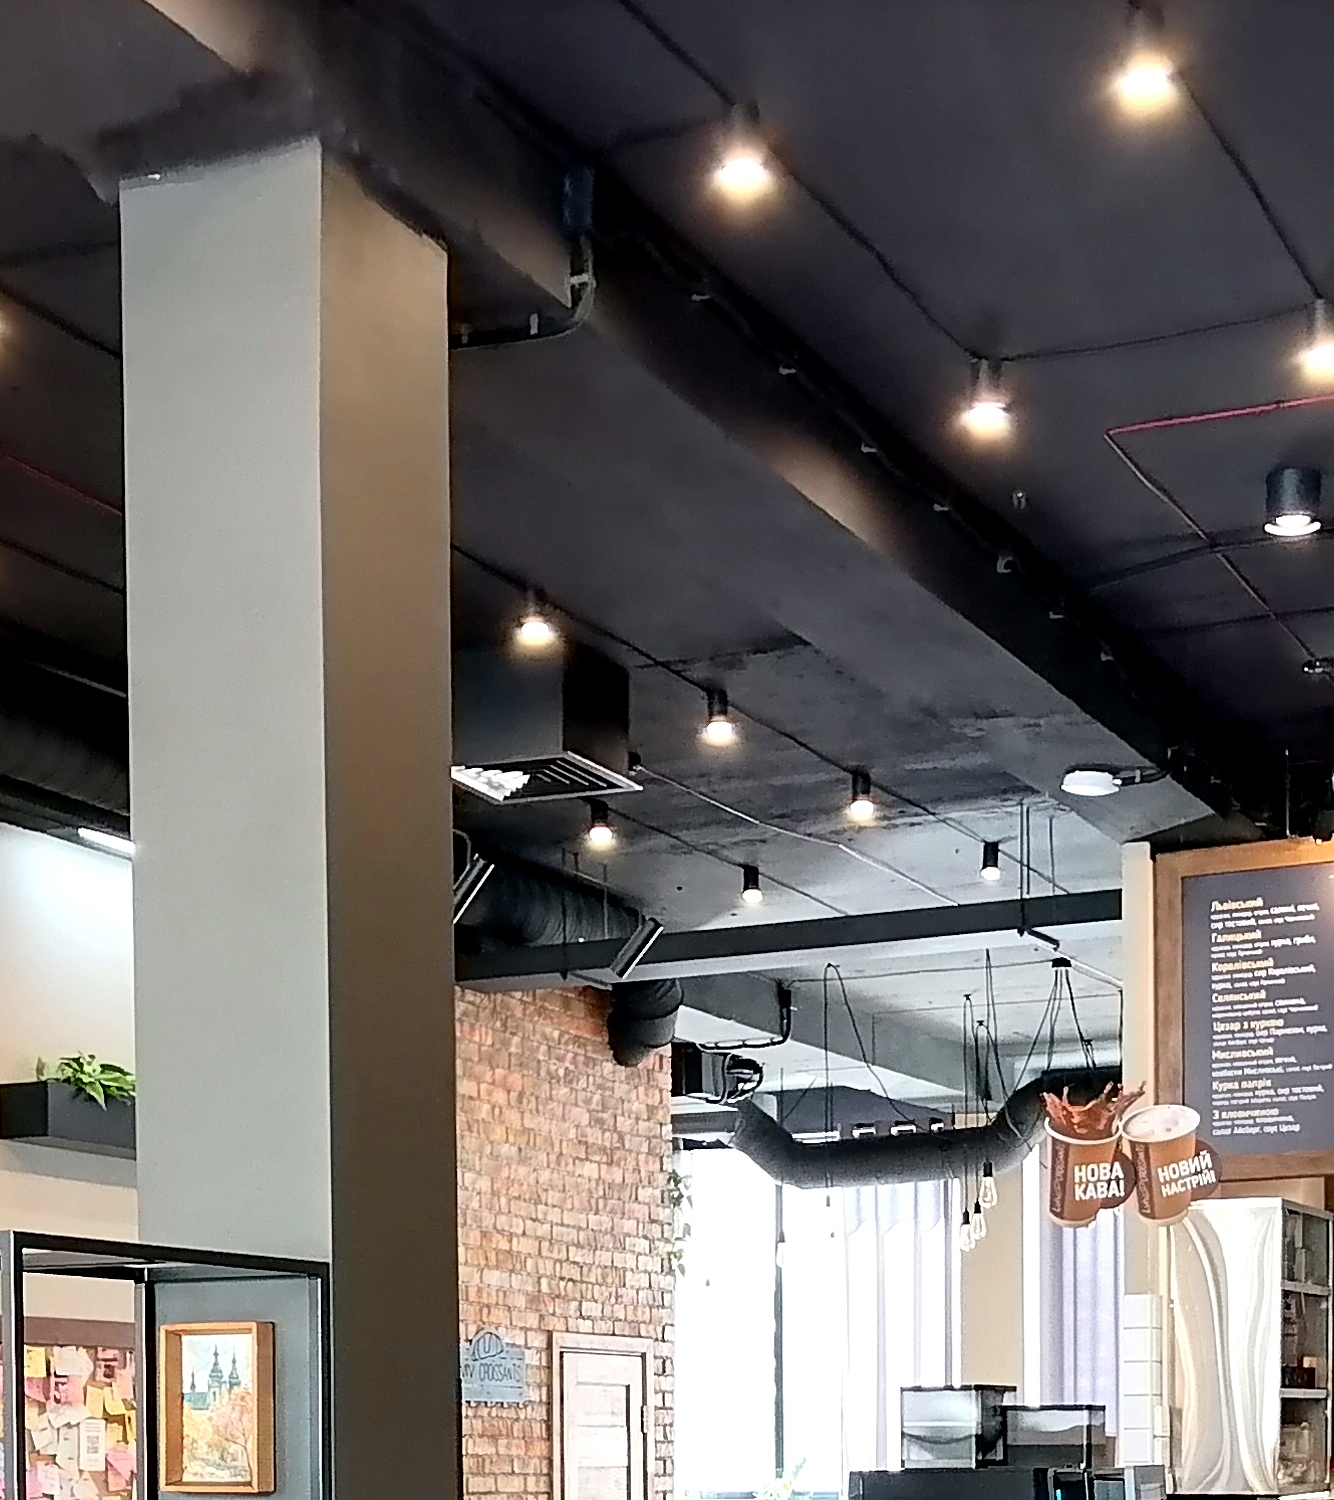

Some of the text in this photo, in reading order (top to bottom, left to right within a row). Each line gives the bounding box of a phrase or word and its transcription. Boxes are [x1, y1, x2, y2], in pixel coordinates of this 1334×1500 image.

[1074, 1162, 1124, 1183] НОВА
[1157, 1150, 1213, 1183] НОВИЙ
[1074, 1180, 1125, 1201] КАВА!
[1161, 1169, 1216, 1198] НАСТРІЙ!
